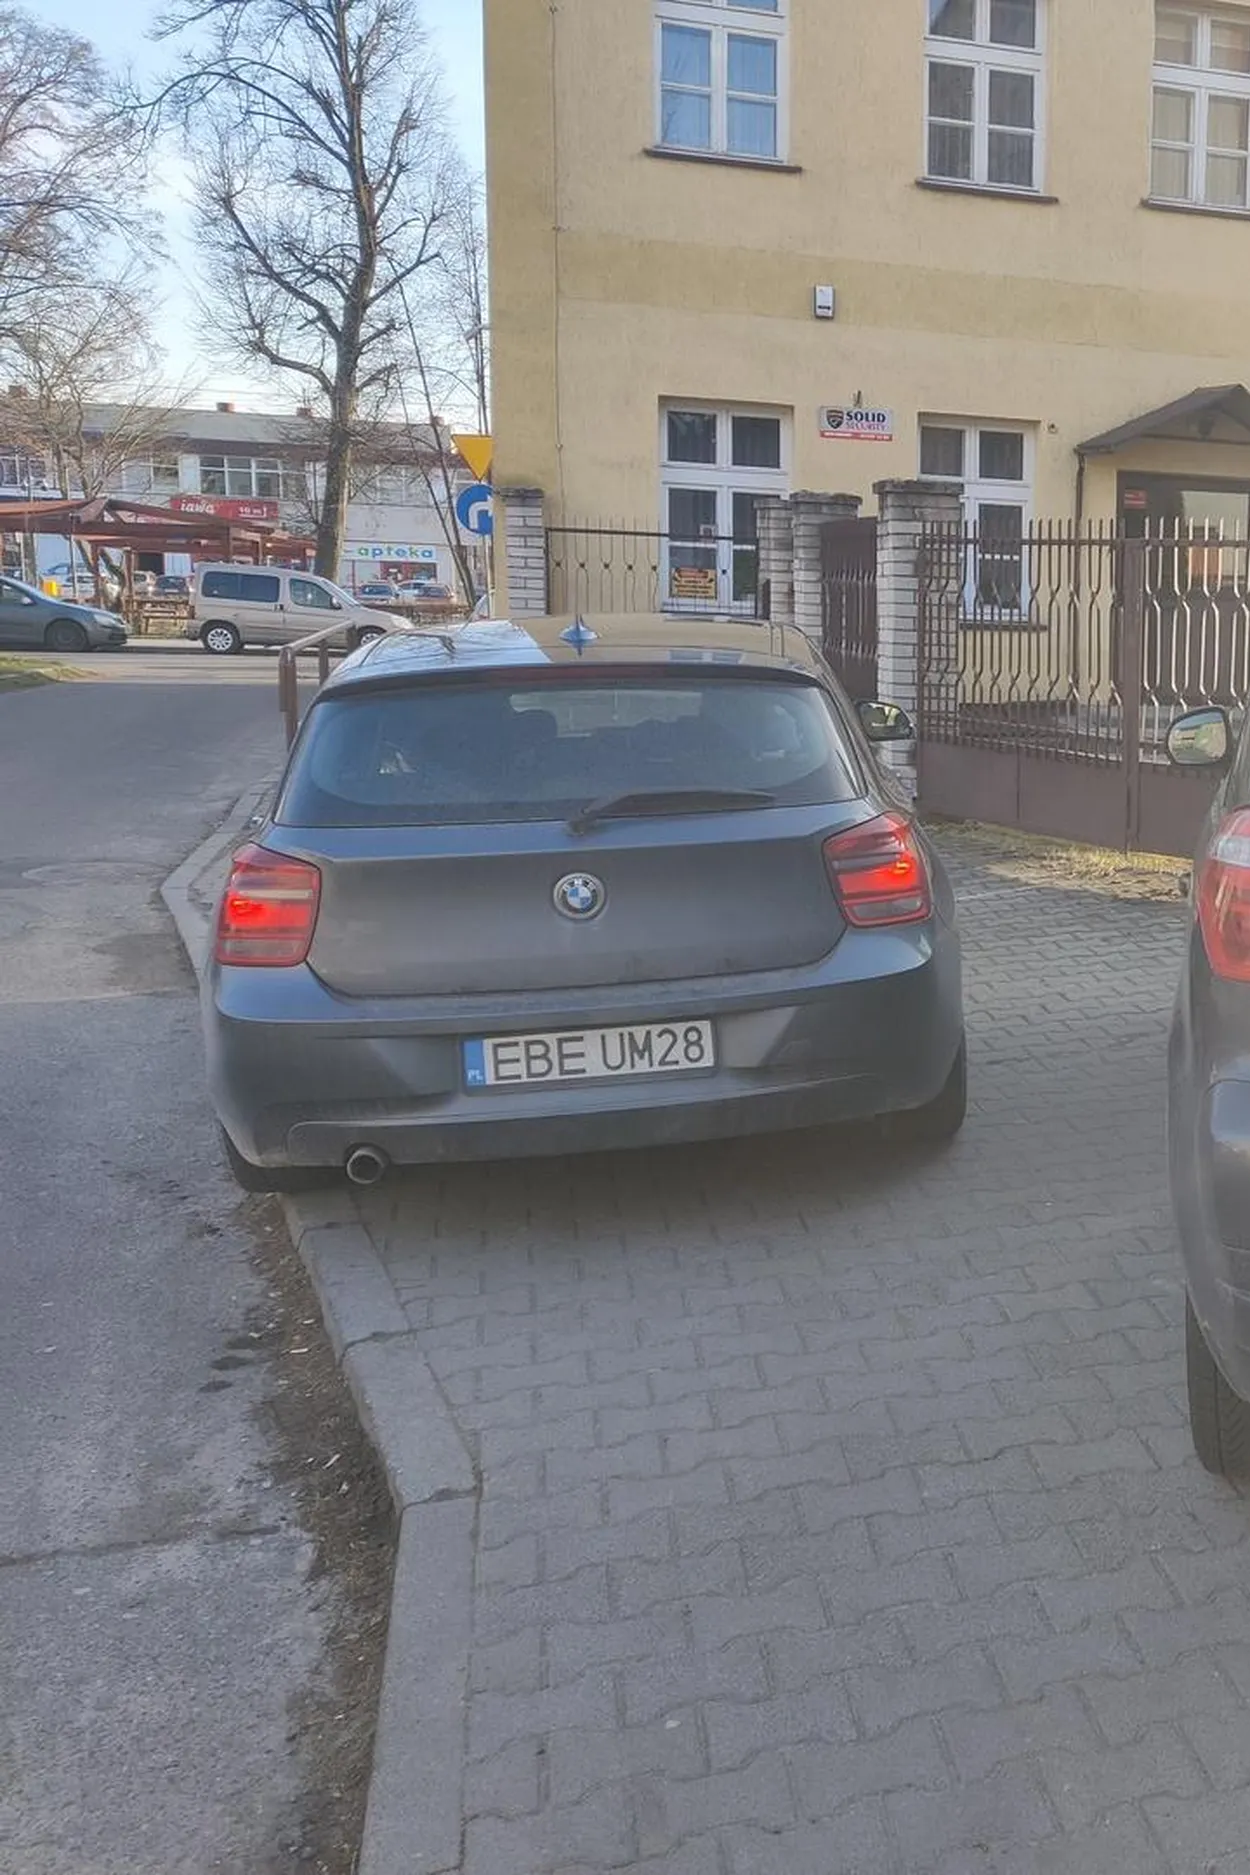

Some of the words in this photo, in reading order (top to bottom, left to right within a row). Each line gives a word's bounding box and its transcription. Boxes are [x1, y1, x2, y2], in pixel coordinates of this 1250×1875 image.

[845, 410, 887, 424] SOLID
[358, 546, 433, 558] apteka
[491, 1035, 587, 1082] EBE
[600, 1025, 705, 1071] UM28
